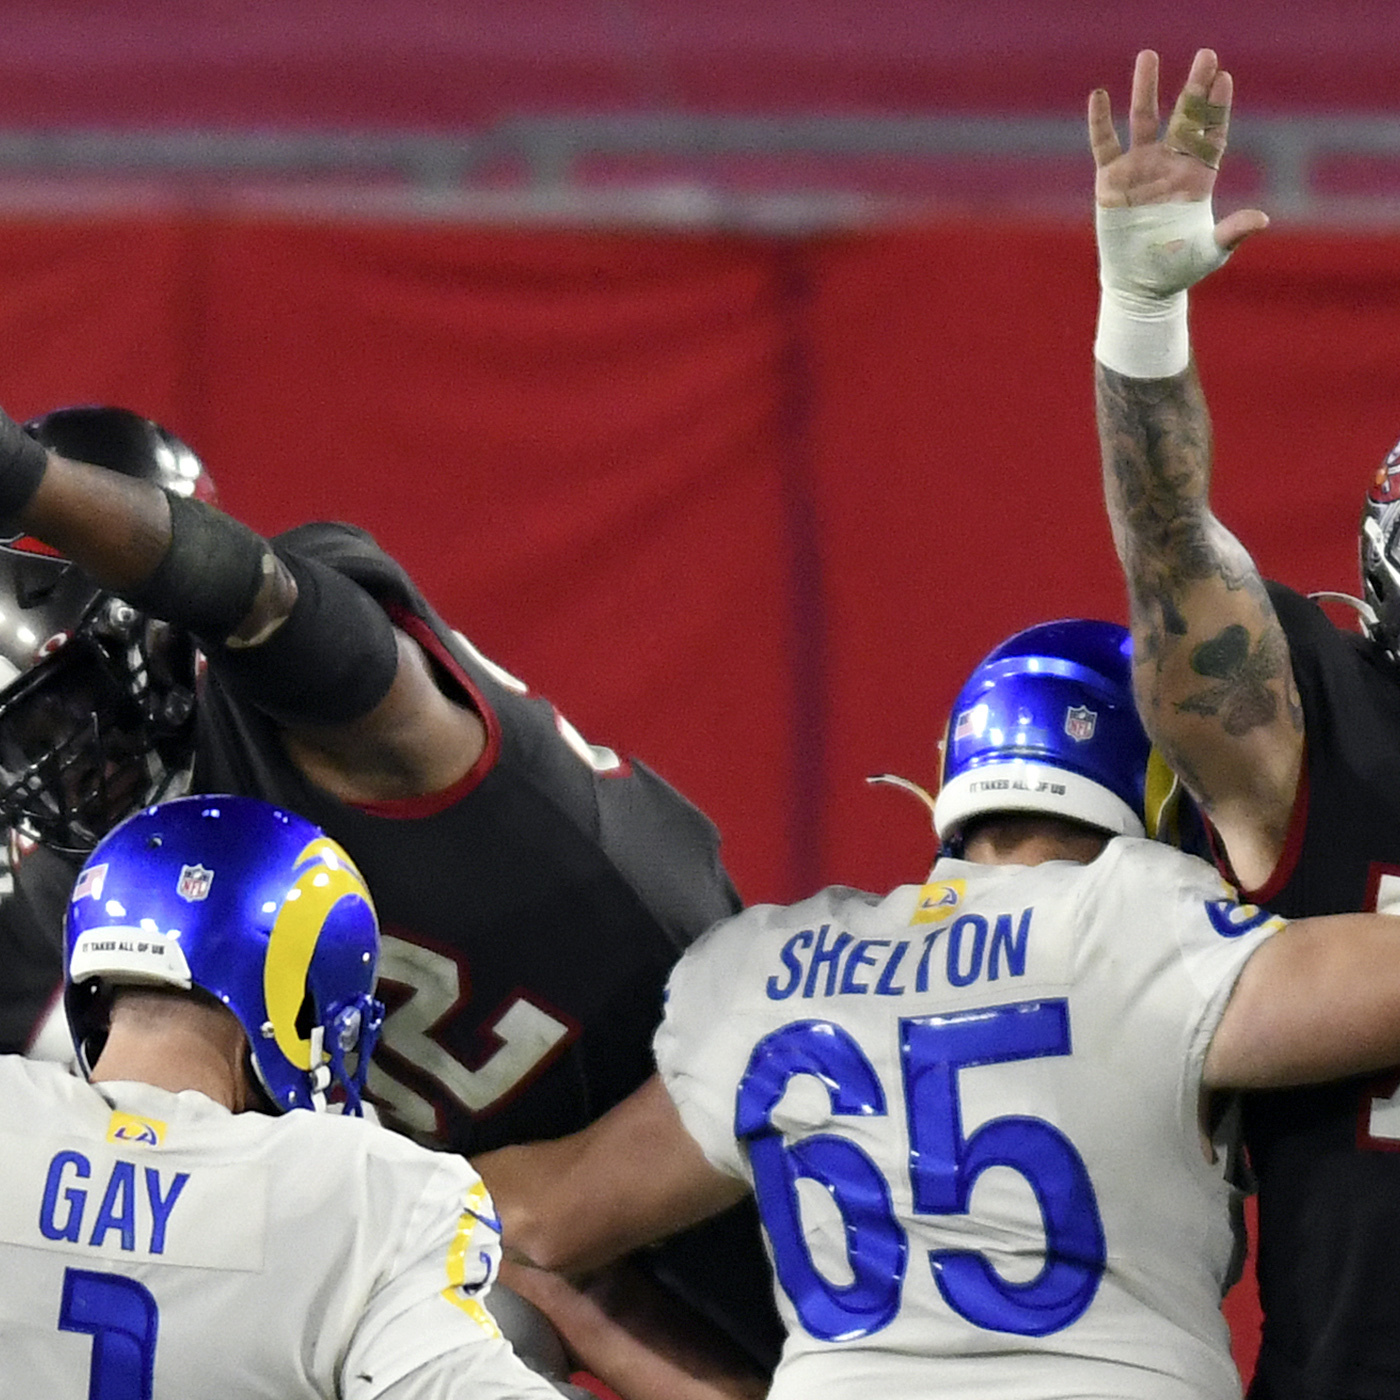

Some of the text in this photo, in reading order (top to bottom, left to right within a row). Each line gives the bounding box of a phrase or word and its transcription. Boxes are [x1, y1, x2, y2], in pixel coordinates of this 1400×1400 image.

[980, 779, 1009, 791] TAKES
[91, 941, 116, 951] TAKES
[118, 942, 134, 952] ALL
[766, 907, 1033, 1000] SHELTON
[38, 1149, 191, 1255] GAY
[734, 996, 1107, 1343] 65
